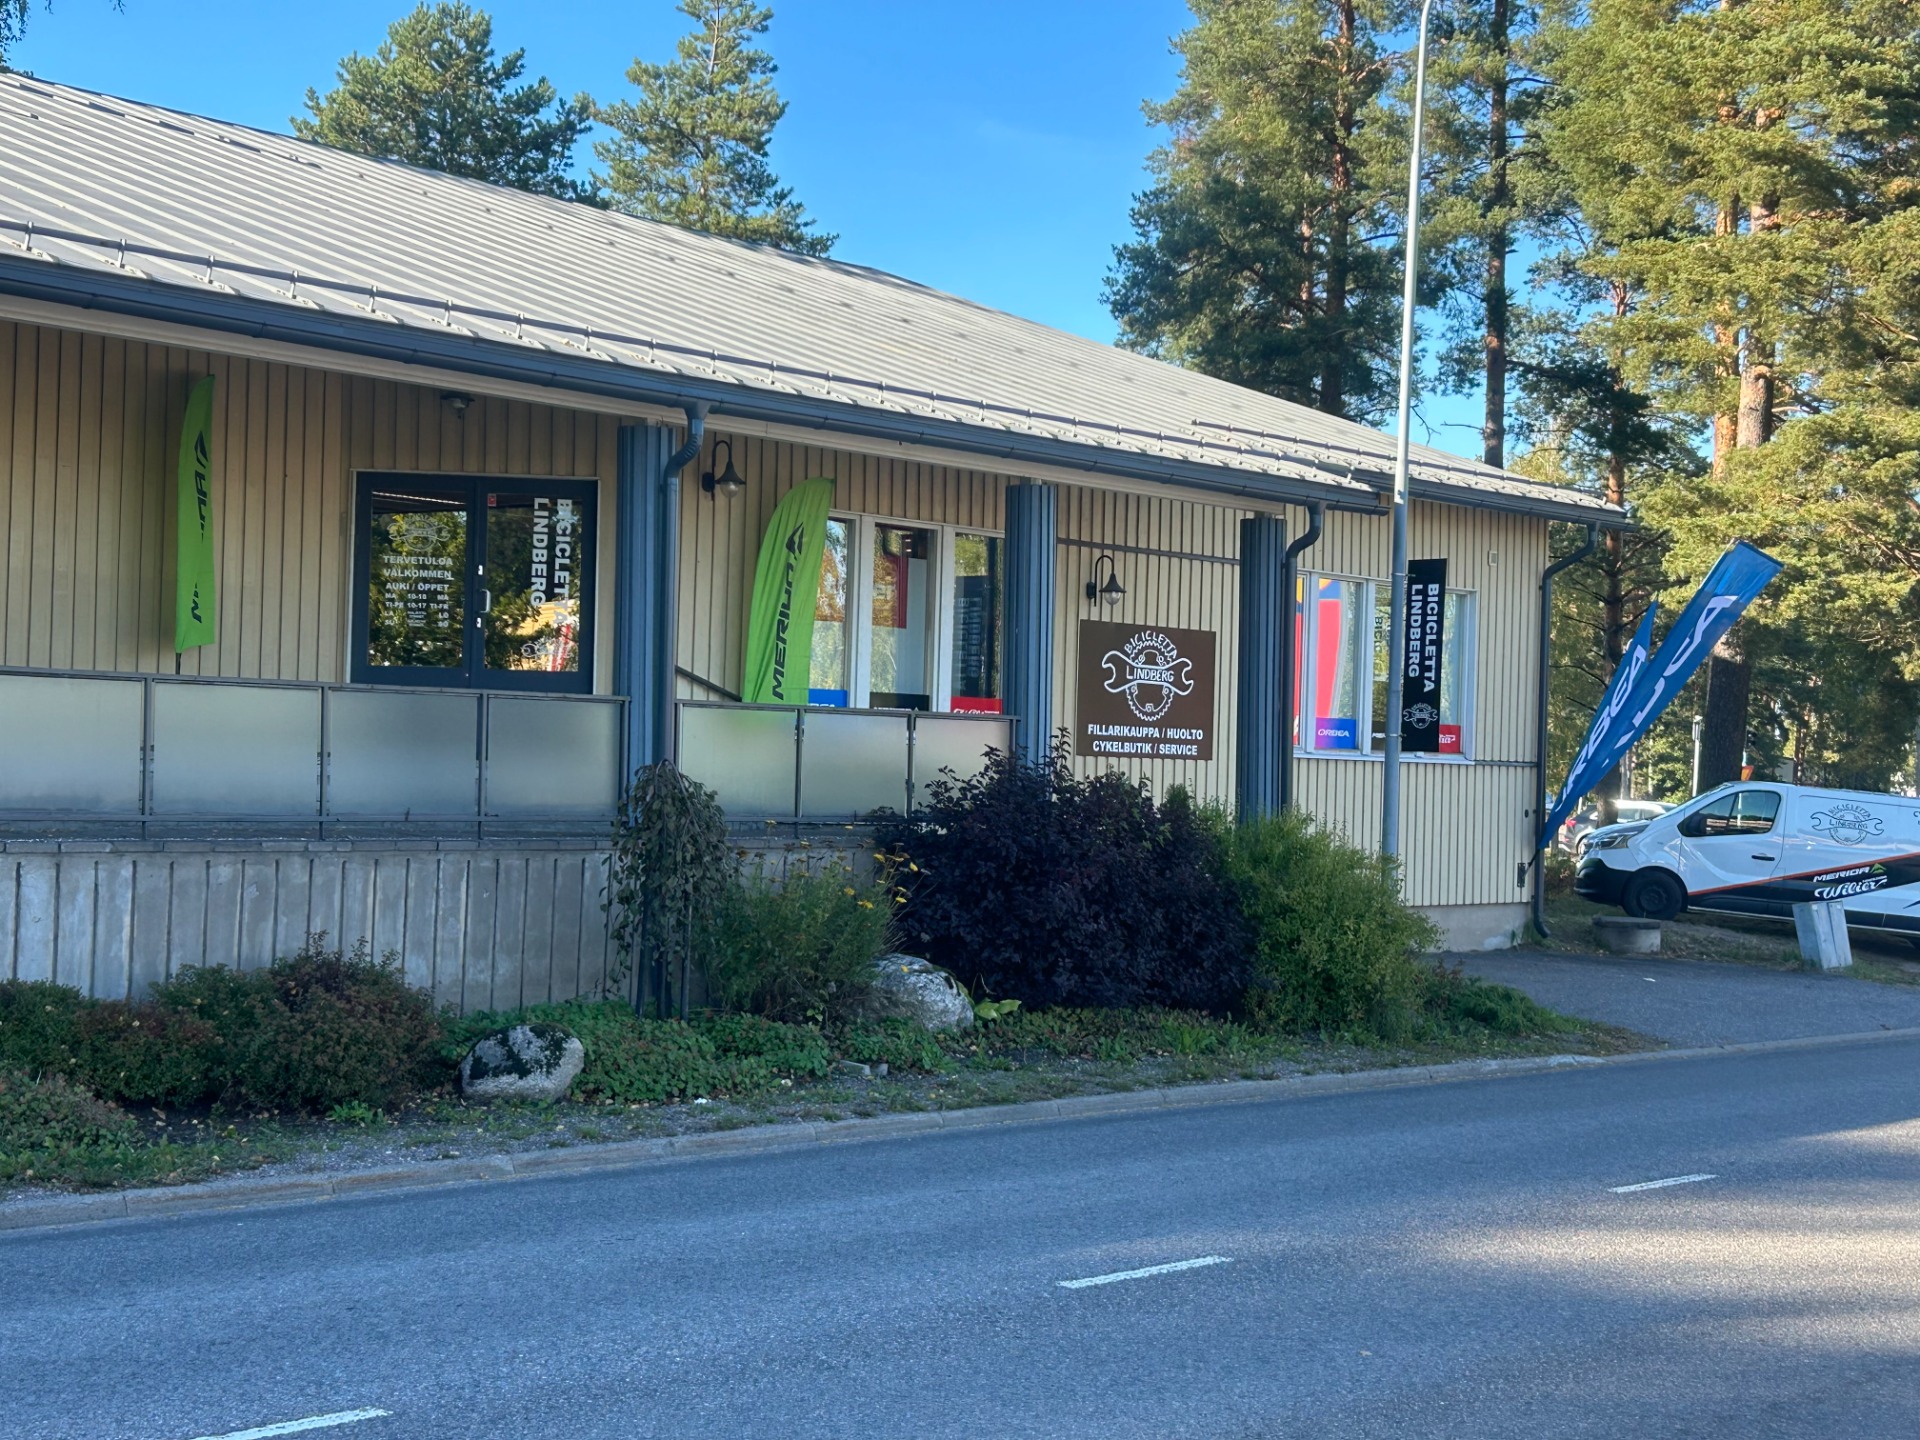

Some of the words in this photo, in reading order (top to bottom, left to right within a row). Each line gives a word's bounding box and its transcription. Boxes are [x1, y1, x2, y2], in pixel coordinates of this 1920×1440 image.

[383, 555, 453, 566] TERVETULOA
[530, 497, 549, 606] LINDBERG
[553, 498, 573, 624] BICICLETTA
[385, 582, 409, 591] AUKI
[1408, 584, 1424, 678] LINDBERG
[1423, 583, 1440, 693] BICICLETTA
[1124, 630, 1178, 659] BICICLETTA
[1126, 665, 1175, 682] LINDBERG
[1087, 723, 1160, 739] FILLARIKAUPPA
[1162, 727, 1165, 739] /
[1166, 728, 1203, 740] HUOLTO
[1555, 644, 1647, 812] RBEA
[1092, 740, 1153, 754] CYKELBUTIK
[1154, 743, 1158, 754] /
[1159, 744, 1198, 756] SERVICE
[1813, 866, 1871, 883] MERIDA
[1814, 878, 1888, 899] Wilier
